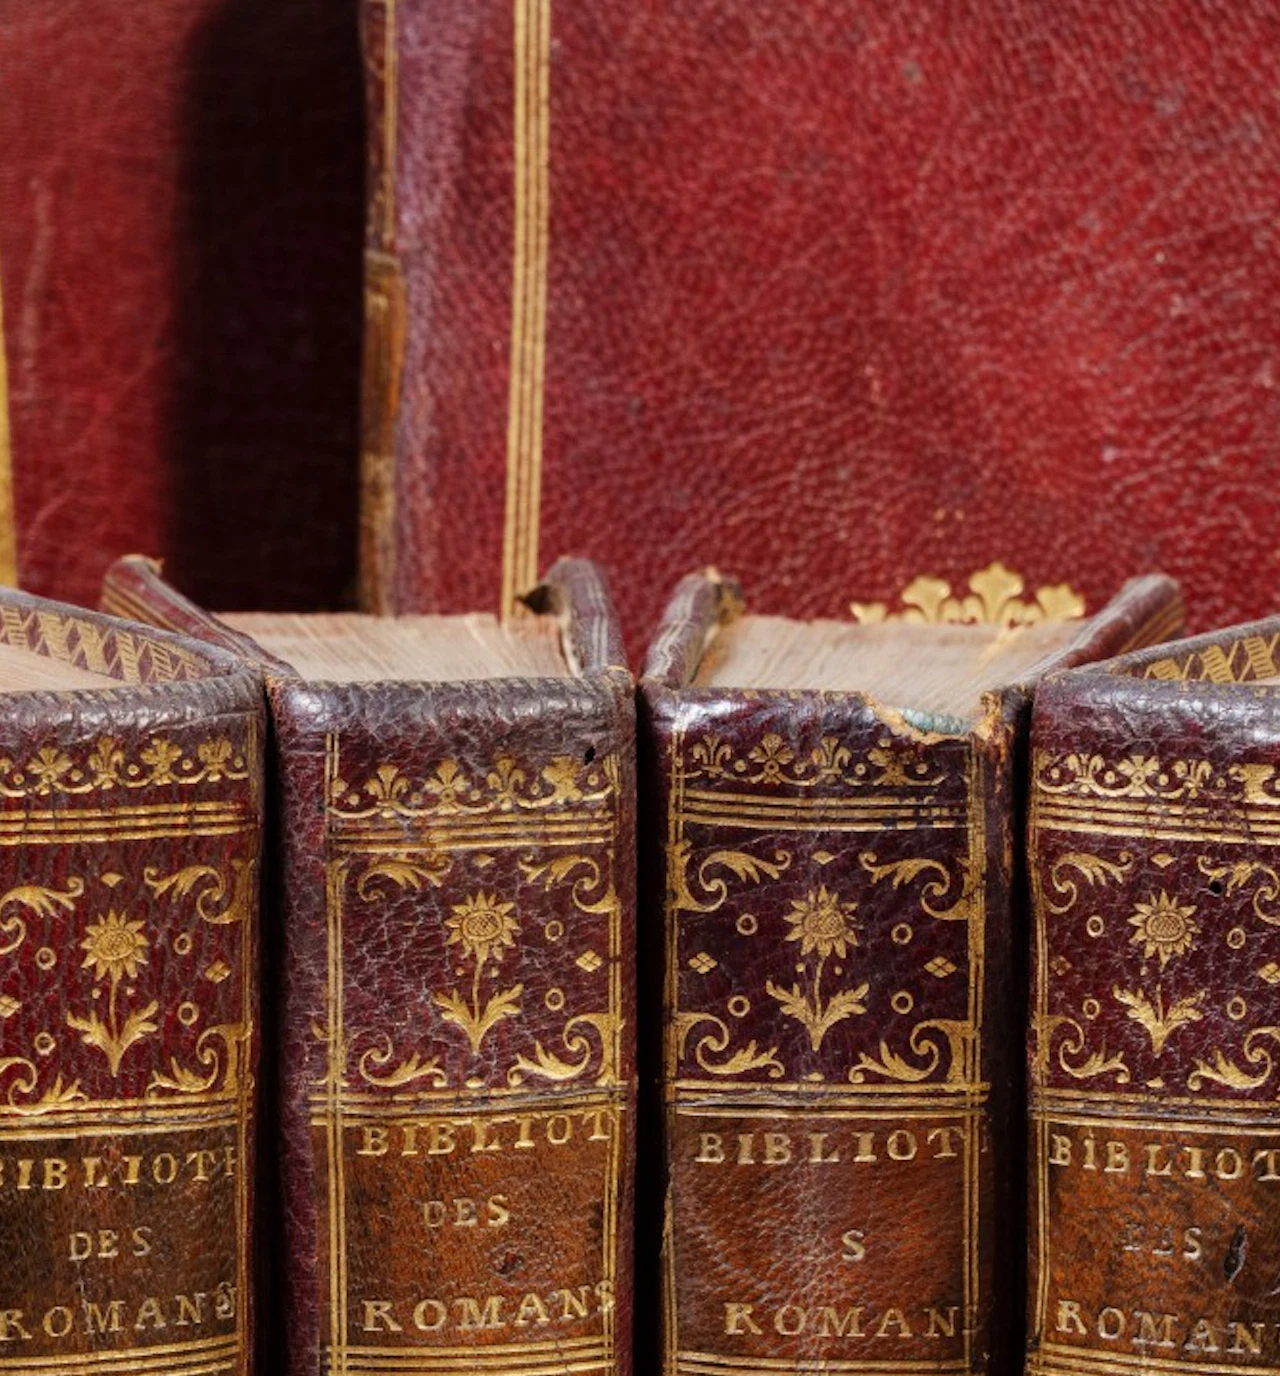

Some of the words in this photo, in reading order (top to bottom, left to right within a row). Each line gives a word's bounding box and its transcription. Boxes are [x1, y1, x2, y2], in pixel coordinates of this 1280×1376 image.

[422, 1195, 510, 1228] DES
[69, 1227, 153, 1261] DES
[363, 1280, 617, 1332] ROMANS
